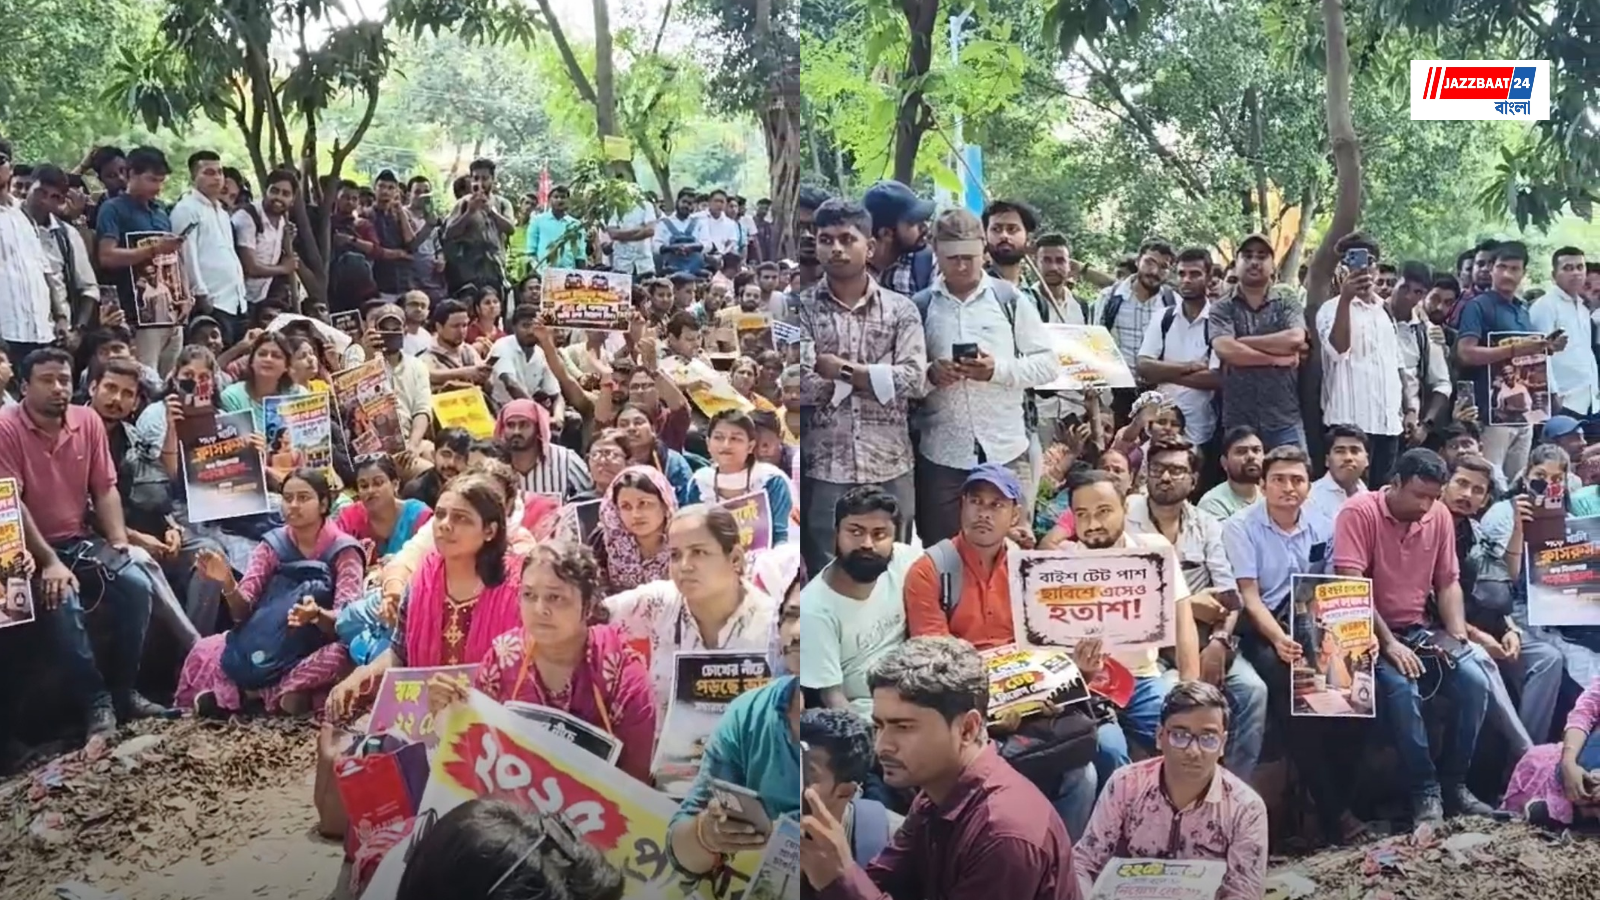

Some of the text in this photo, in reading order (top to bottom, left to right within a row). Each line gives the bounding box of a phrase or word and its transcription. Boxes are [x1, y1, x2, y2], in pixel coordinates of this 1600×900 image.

[1039, 568, 1147, 584] বাইশ টেট পাশ
[1100, 584, 1147, 597] এসেও
[1046, 598, 1142, 625] হতাশ!
[702, 658, 766, 678] চোখের নীচে
[695, 679, 741, 697] পড়ছে
